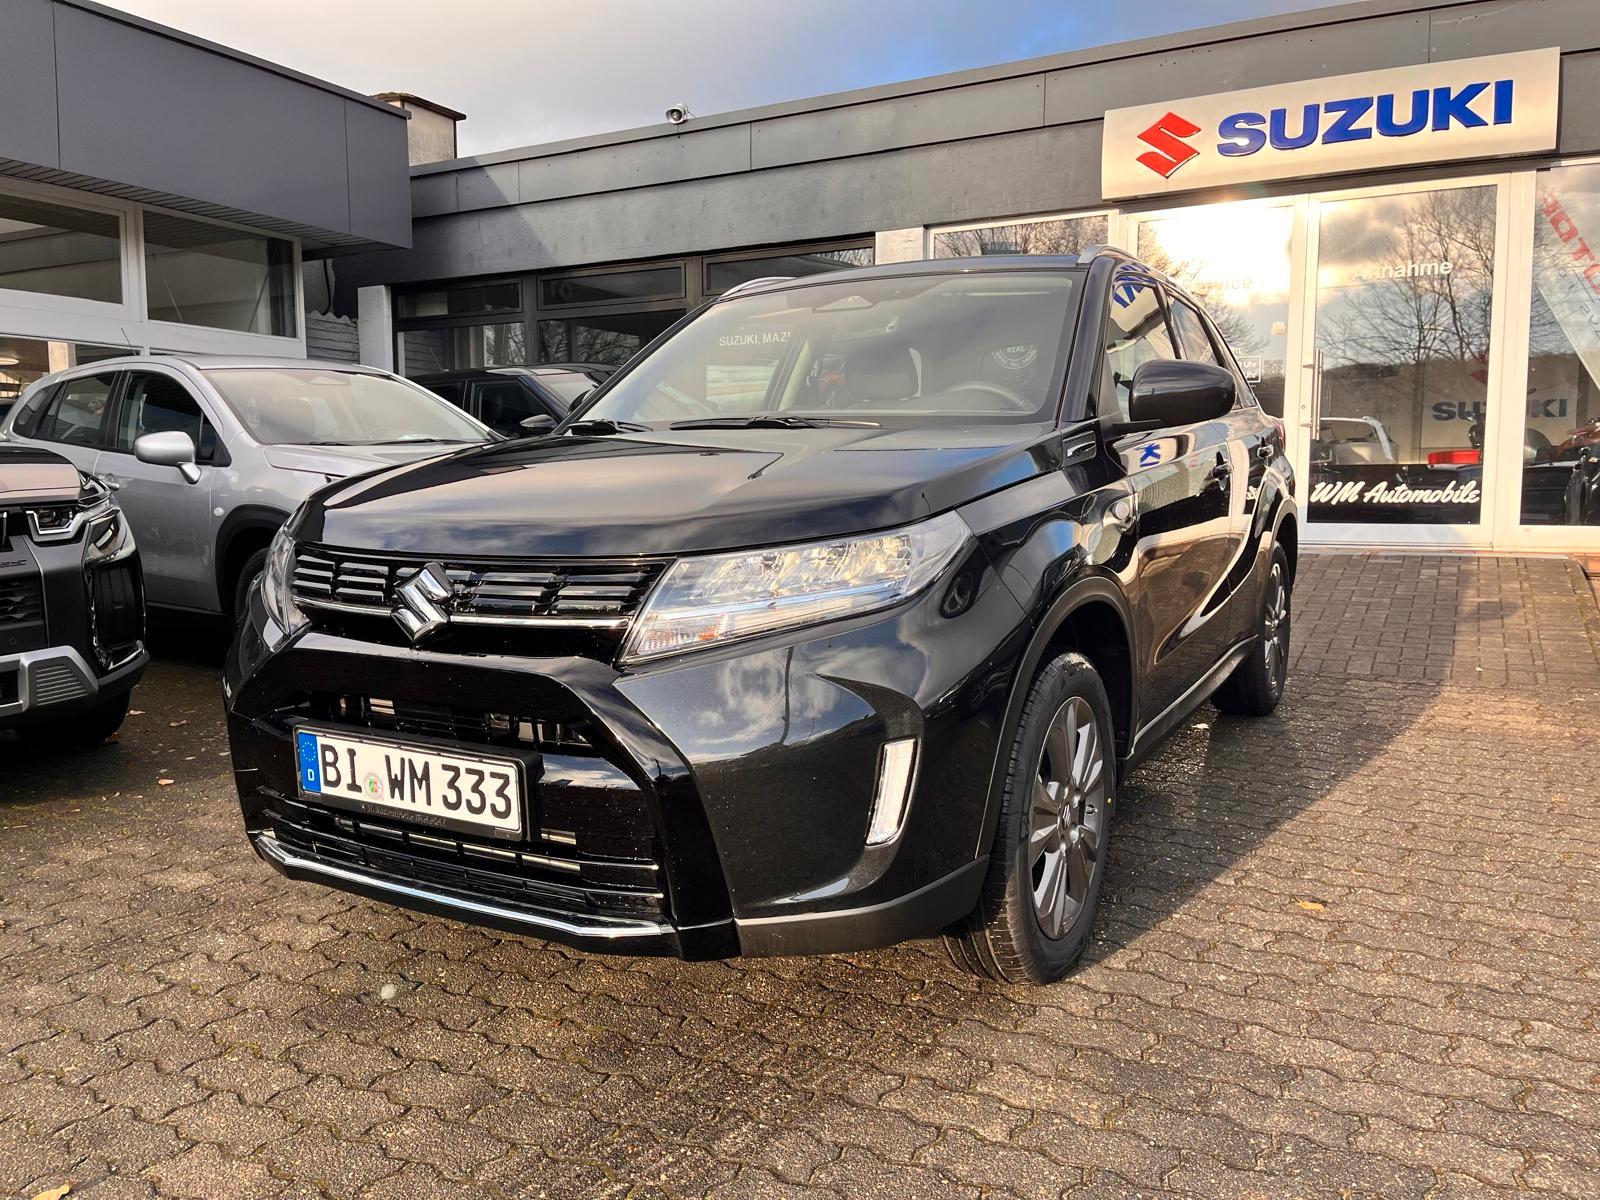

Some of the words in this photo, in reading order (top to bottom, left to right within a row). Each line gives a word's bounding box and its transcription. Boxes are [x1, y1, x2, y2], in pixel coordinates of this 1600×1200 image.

[1217, 79, 1514, 157] SUZUKI
[1351, 260, 1454, 281] Annahme
[762, 331, 792, 344] MAZ
[1310, 481, 1365, 505] WM
[1363, 480, 1480, 504] Automobile
[307, 768, 315, 781] D
[320, 743, 363, 793] BI
[385, 754, 432, 806] WM
[441, 763, 512, 819] 333
